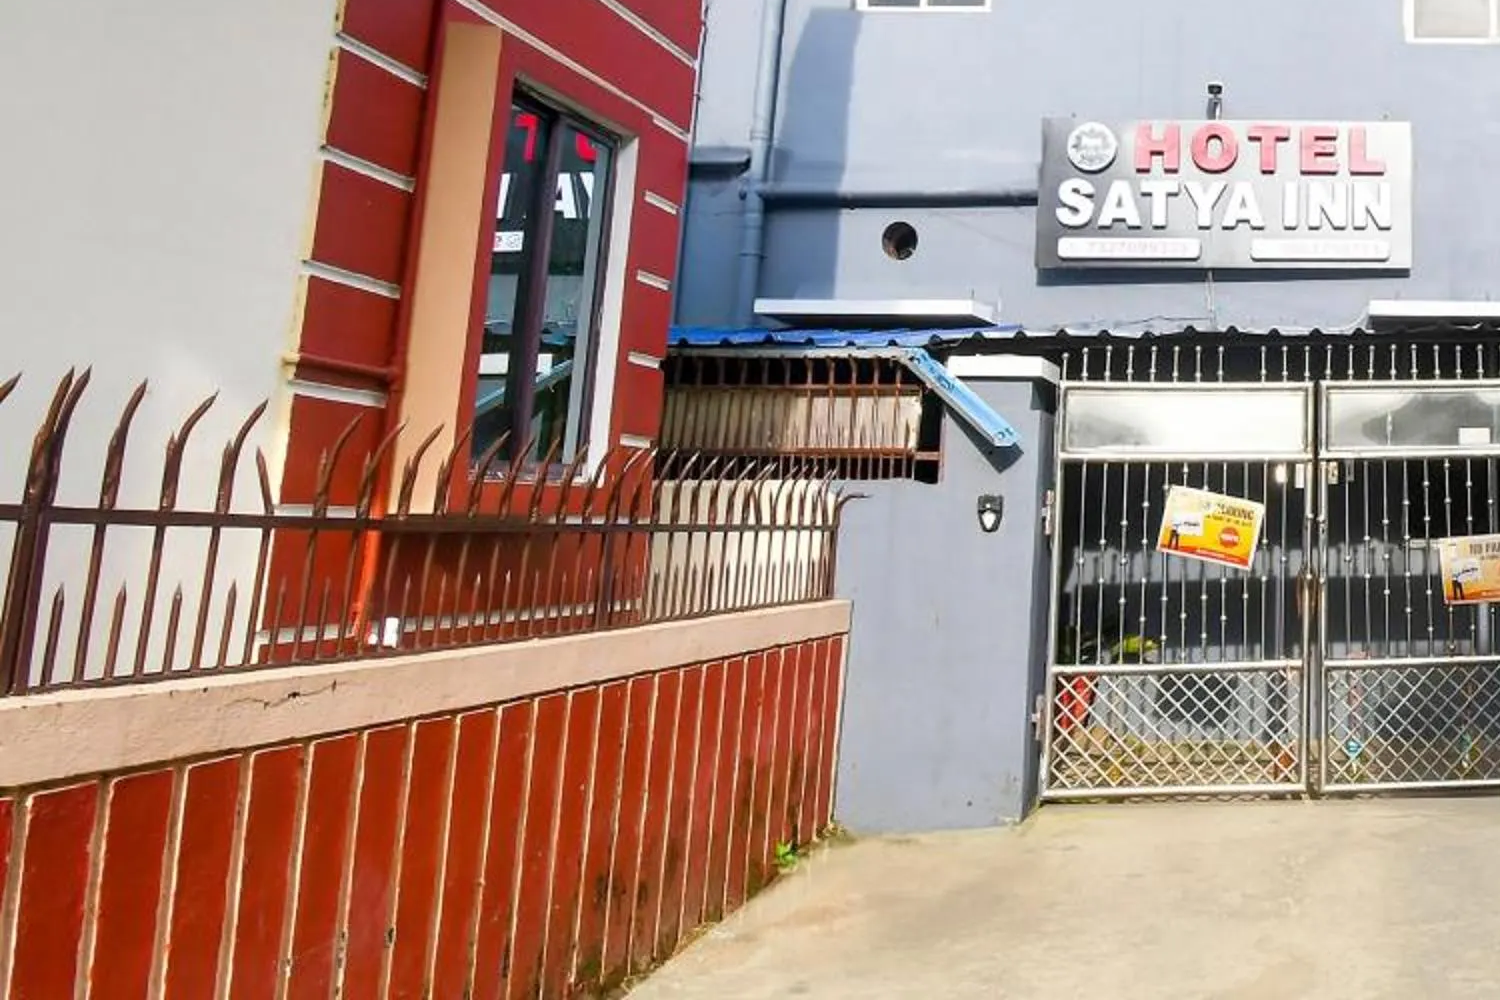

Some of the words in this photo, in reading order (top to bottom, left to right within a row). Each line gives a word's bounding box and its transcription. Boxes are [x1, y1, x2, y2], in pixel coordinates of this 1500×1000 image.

[1135, 122, 1387, 175] HOTEL
[1055, 178, 1265, 231] SATYA
[1281, 180, 1392, 231] INN
